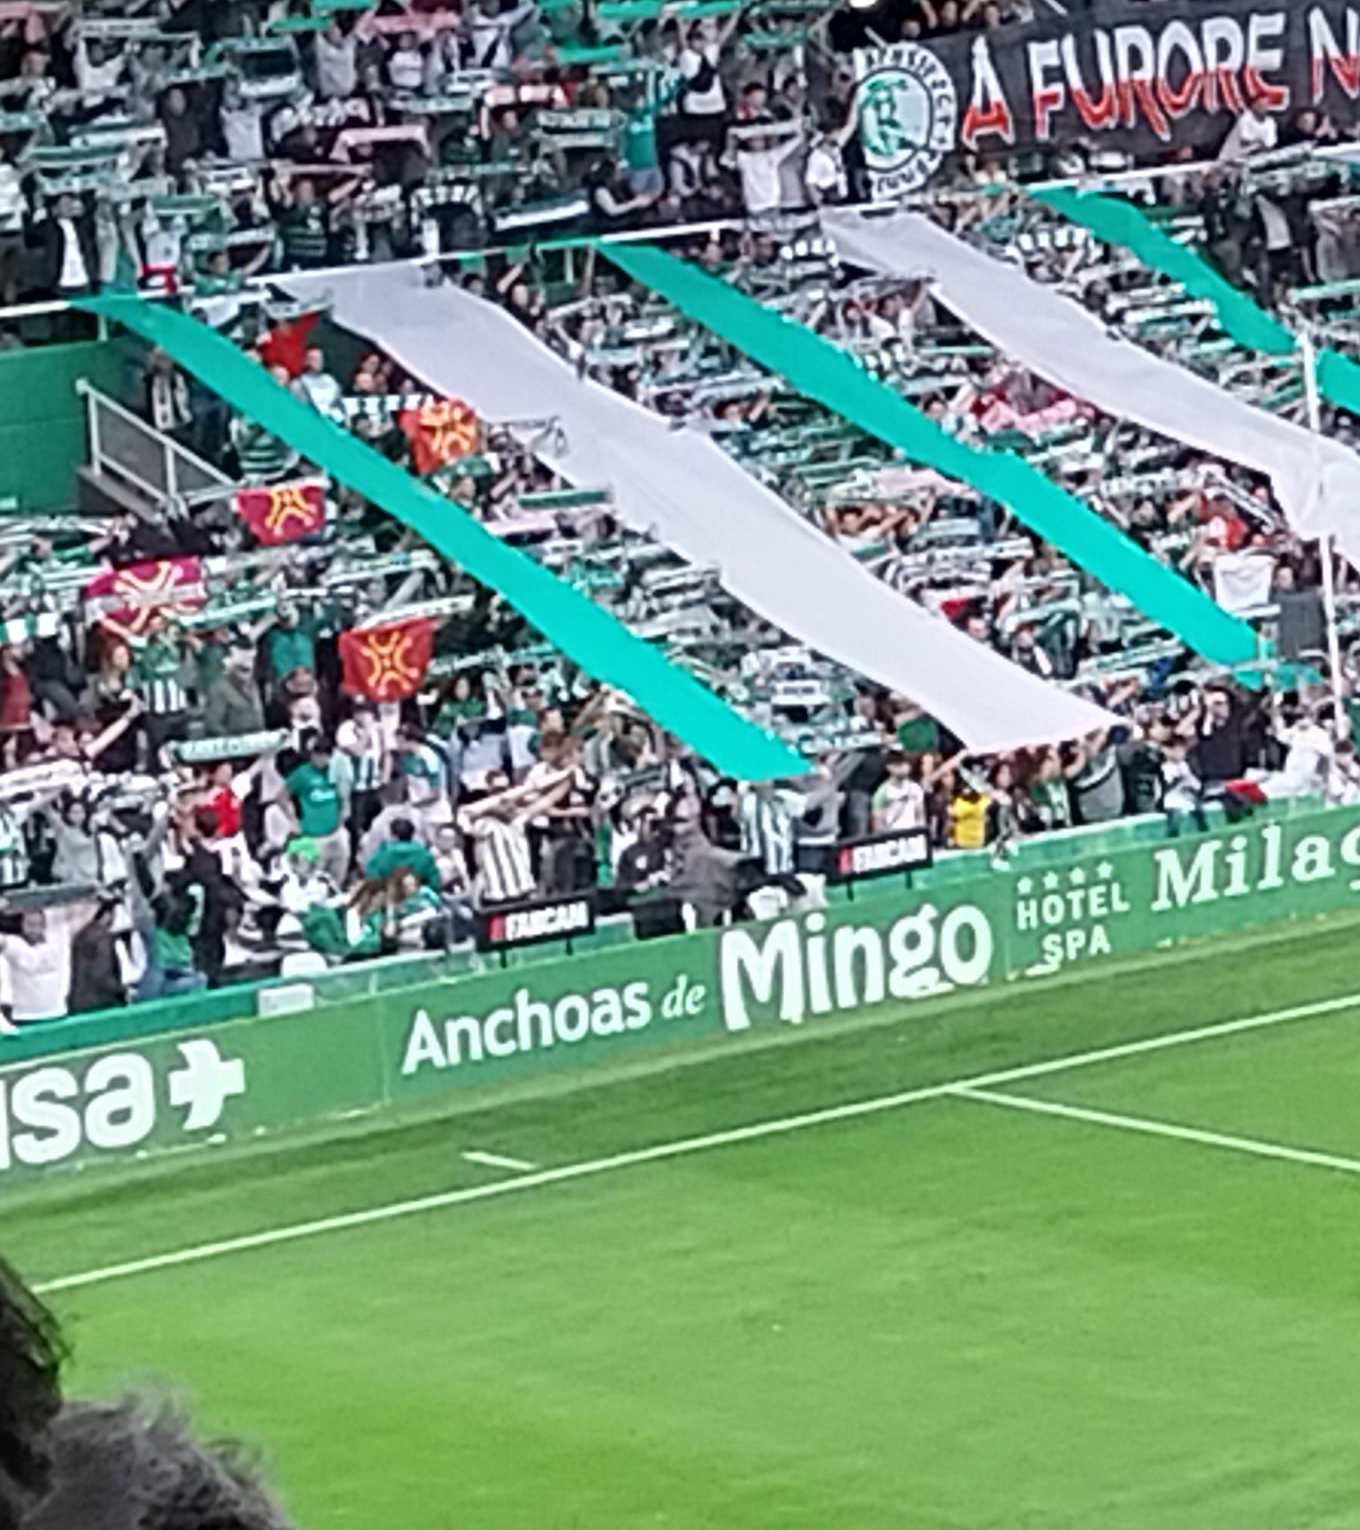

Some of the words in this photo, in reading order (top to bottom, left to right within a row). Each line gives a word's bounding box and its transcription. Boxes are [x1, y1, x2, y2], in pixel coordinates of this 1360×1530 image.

[961, 35, 1014, 149] A
[1028, 12, 1290, 142] FURORE
[1017, 882, 1129, 932] HOTEL
[1042, 931, 1110, 965] SPA
[402, 980, 651, 1076] Anchoas
[660, 974, 706, 1020] de
[720, 903, 992, 1032] Mingo
